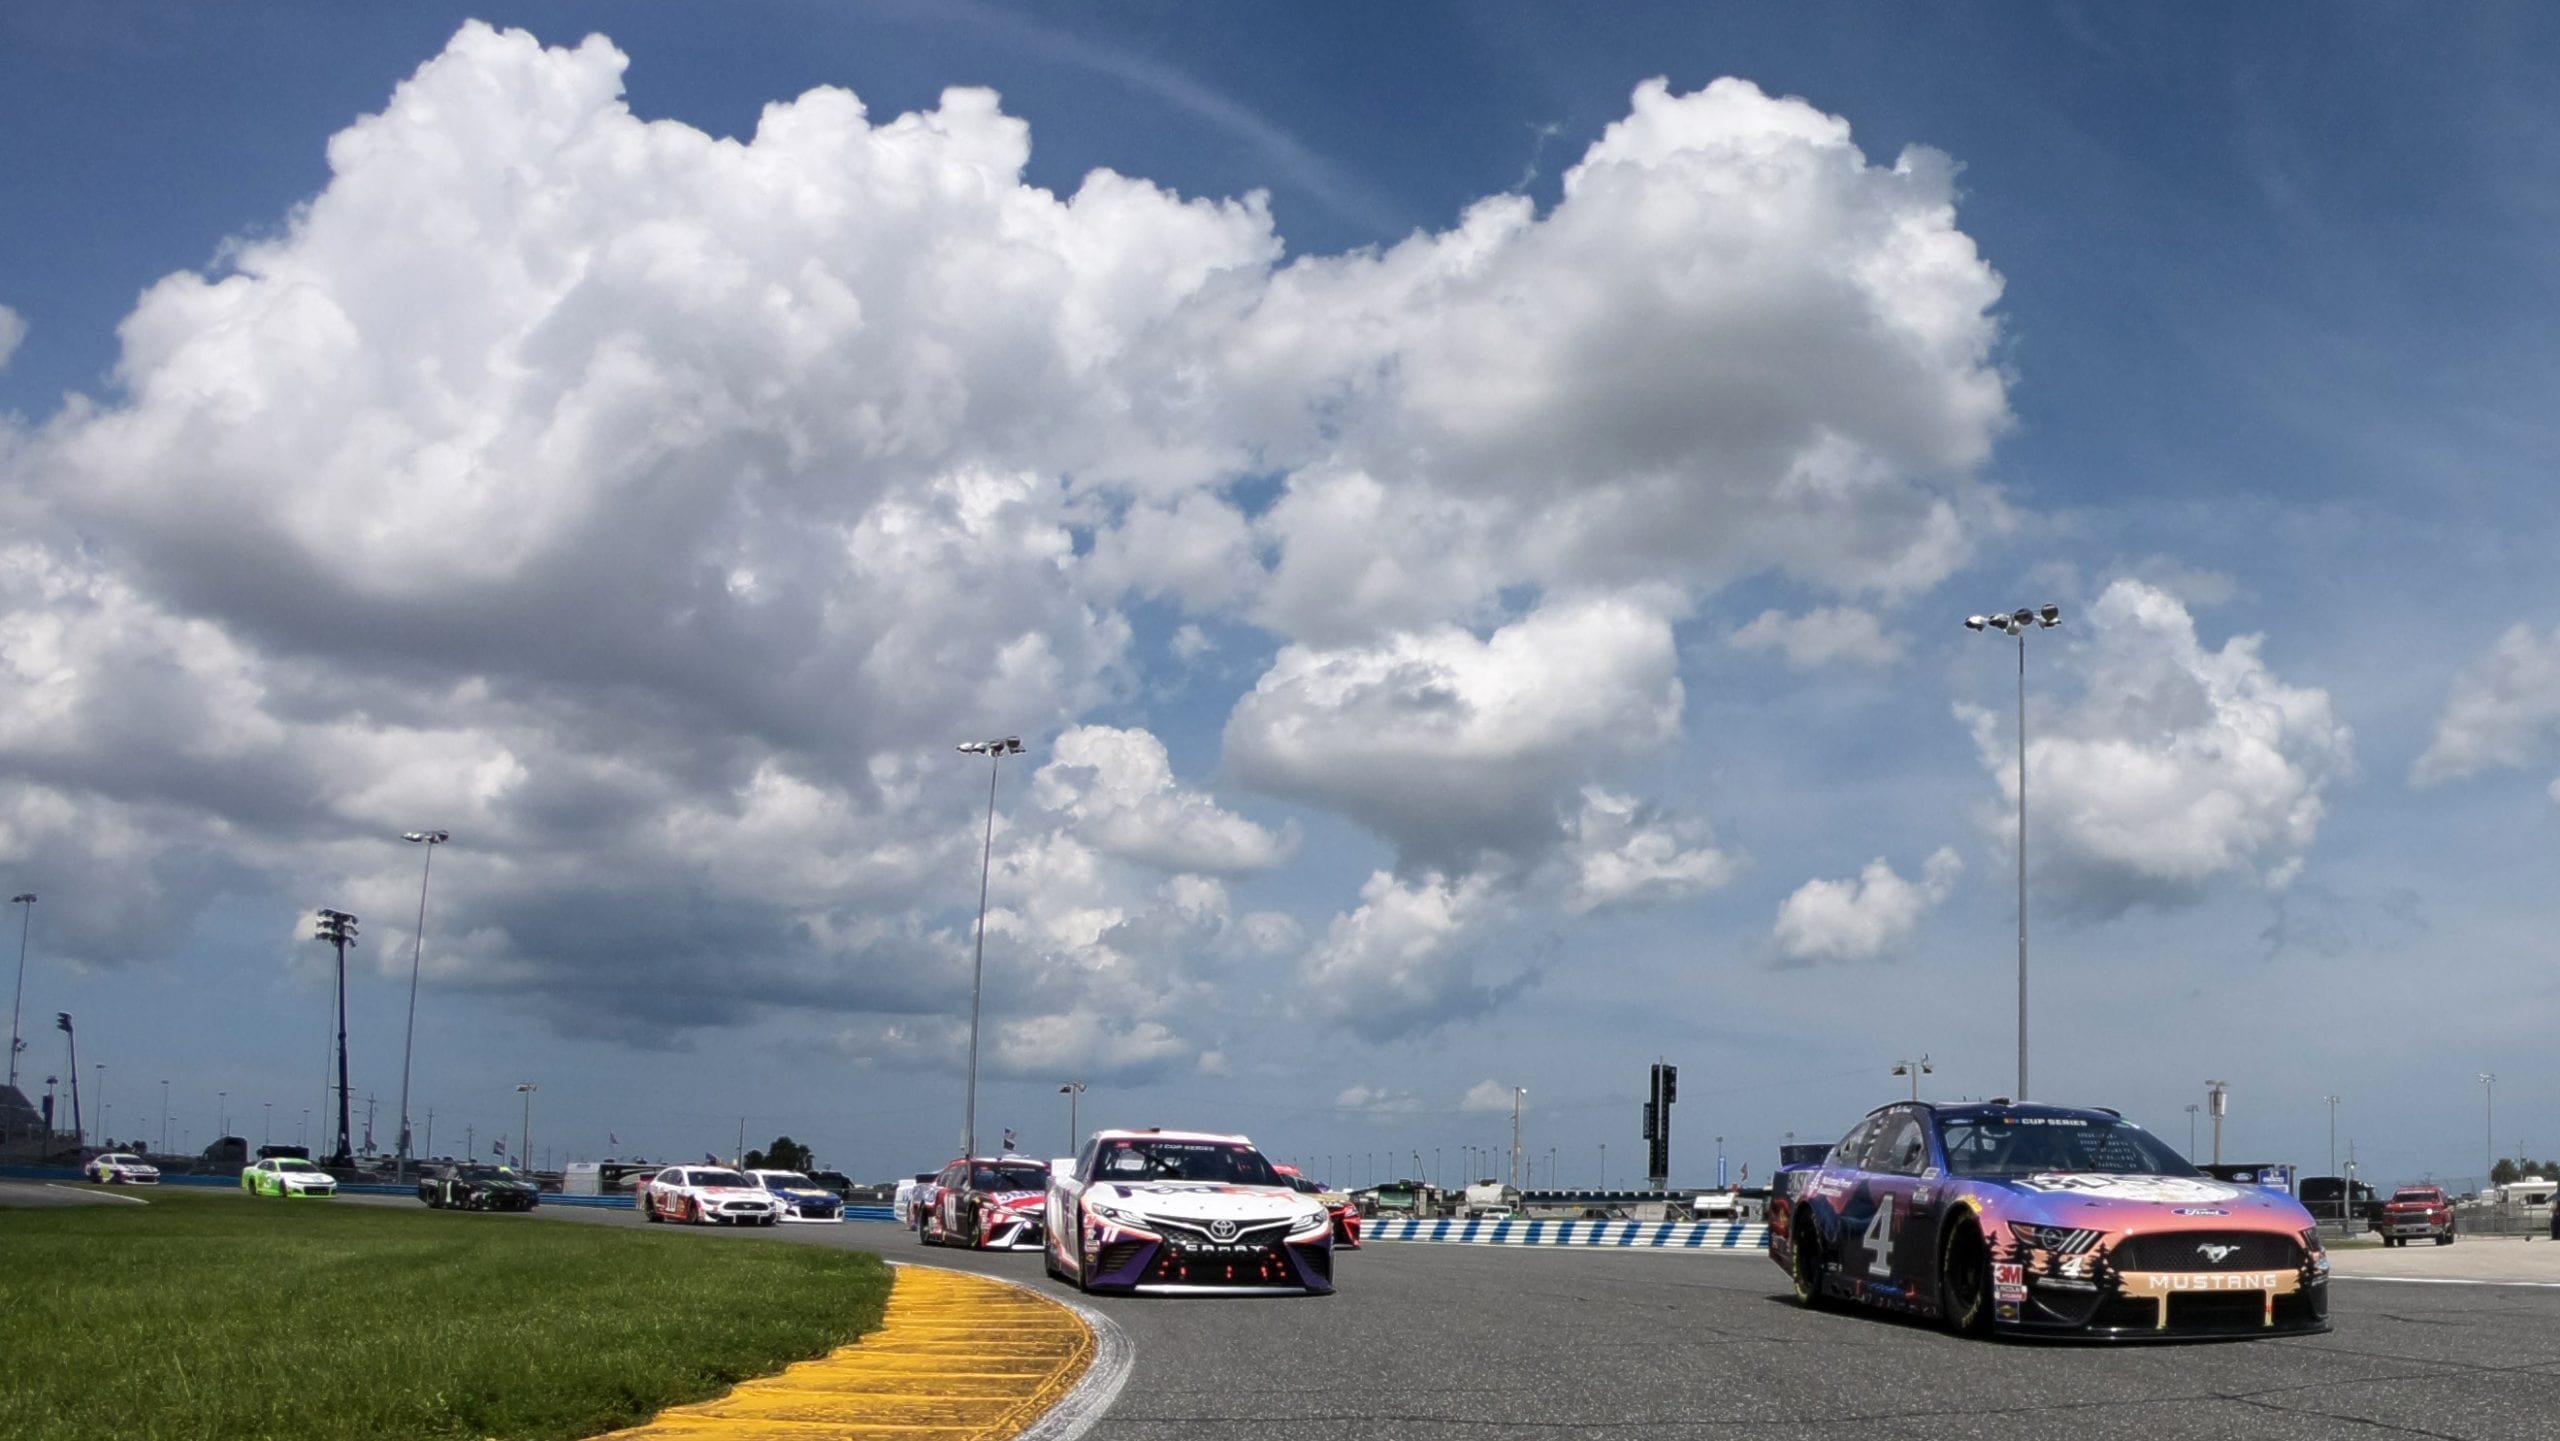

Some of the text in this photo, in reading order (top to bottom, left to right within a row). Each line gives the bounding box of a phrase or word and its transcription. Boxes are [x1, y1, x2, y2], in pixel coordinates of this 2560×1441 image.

[2047, 1118, 2088, 1127] SERIES
[1101, 1226, 1121, 1243] 11
[1863, 1194, 1894, 1276] 4
[1996, 1265, 2021, 1285] 3M
[2060, 1257, 2082, 1276] 4
[2149, 1274, 2277, 1289] MUSTANG
